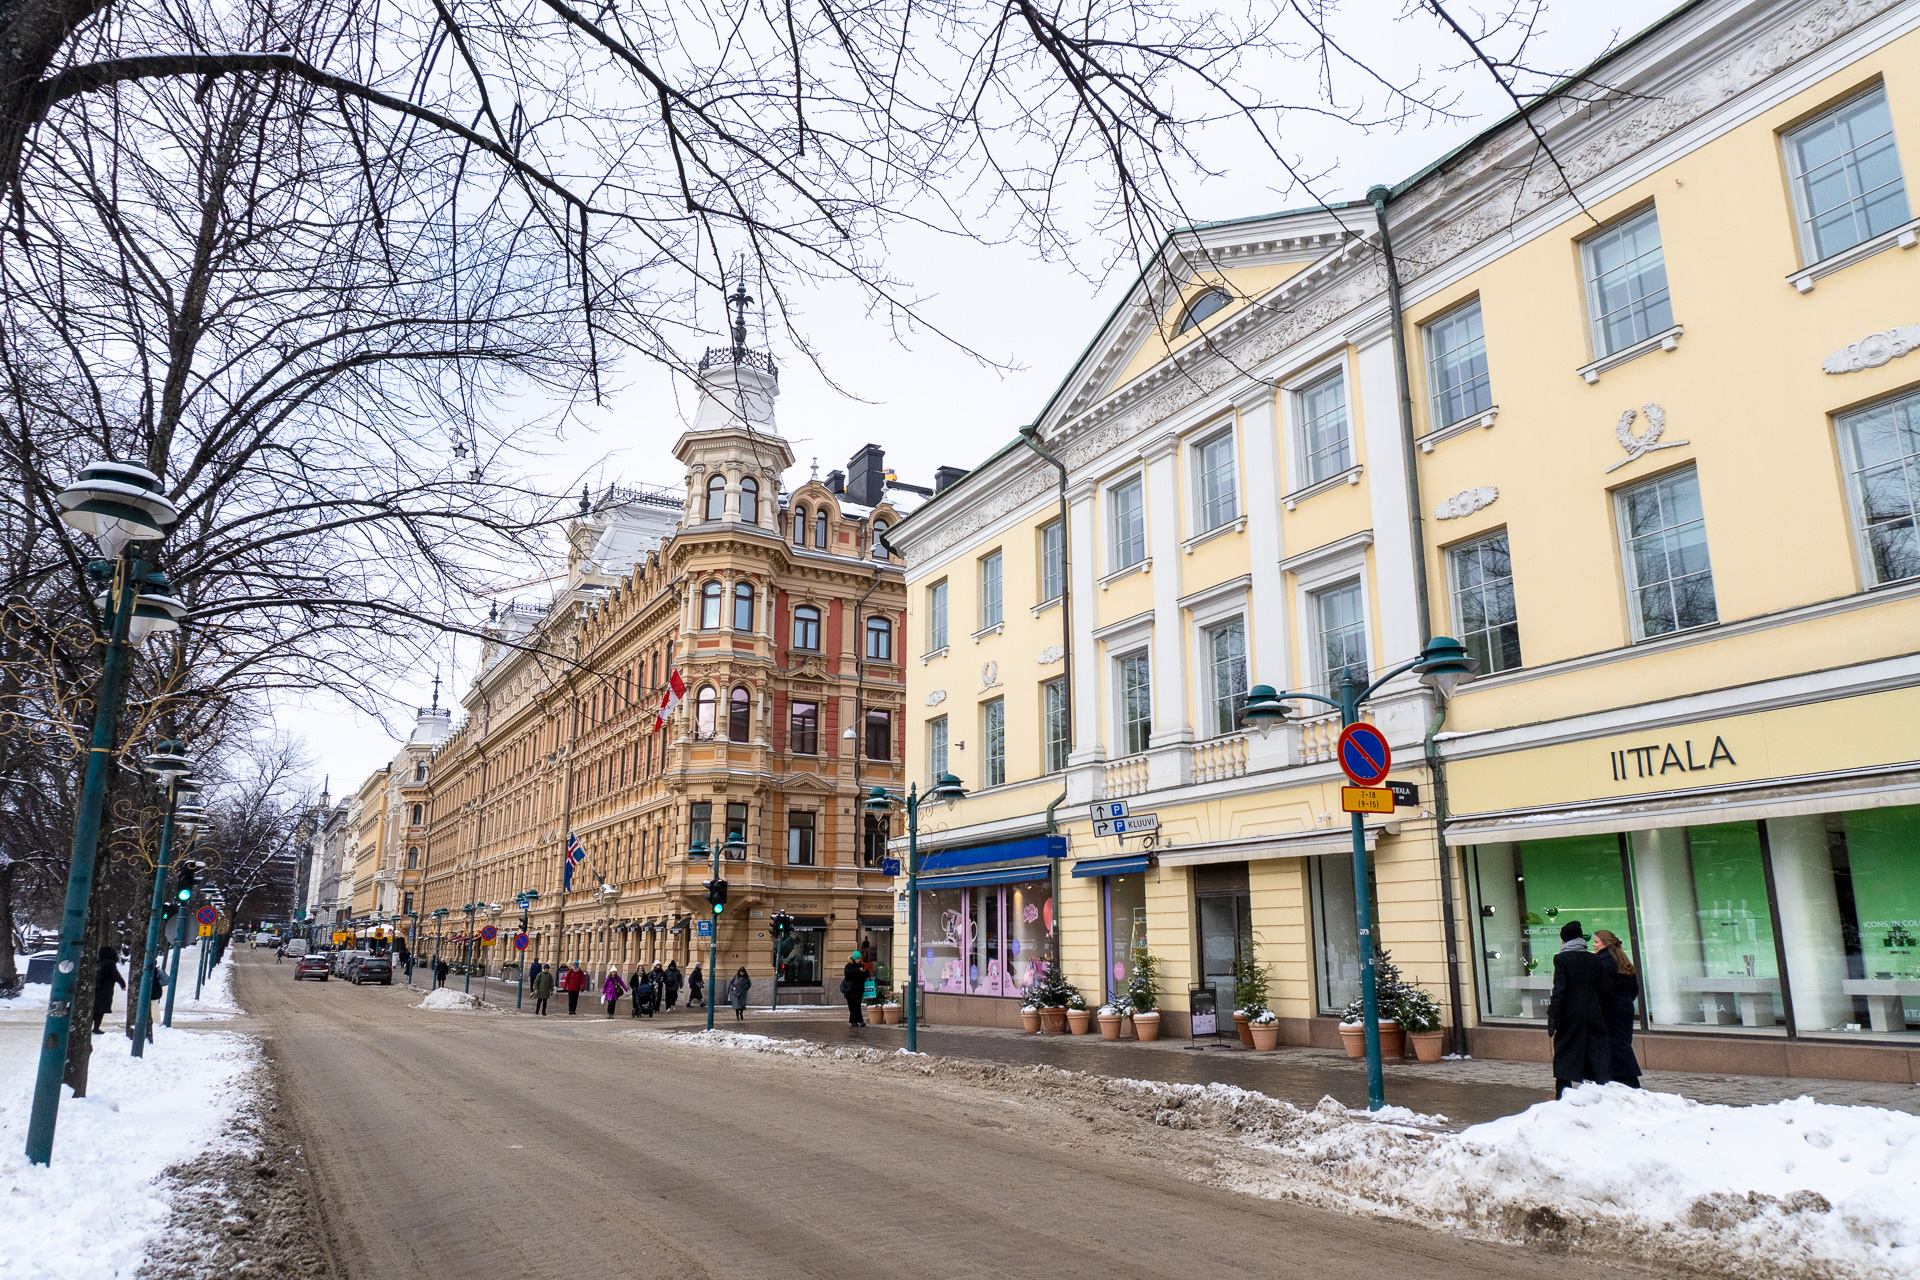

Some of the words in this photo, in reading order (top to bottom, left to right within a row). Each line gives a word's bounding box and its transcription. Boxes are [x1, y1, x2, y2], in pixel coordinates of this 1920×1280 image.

[1611, 735, 1737, 781] IITTALA
[1361, 791, 1376, 799] 7-18
[1358, 800, 1379, 809] (9-15)
[1113, 805, 1120, 814] P
[1116, 821, 1123, 831] P
[1128, 818, 1155, 828] KLUUVI
